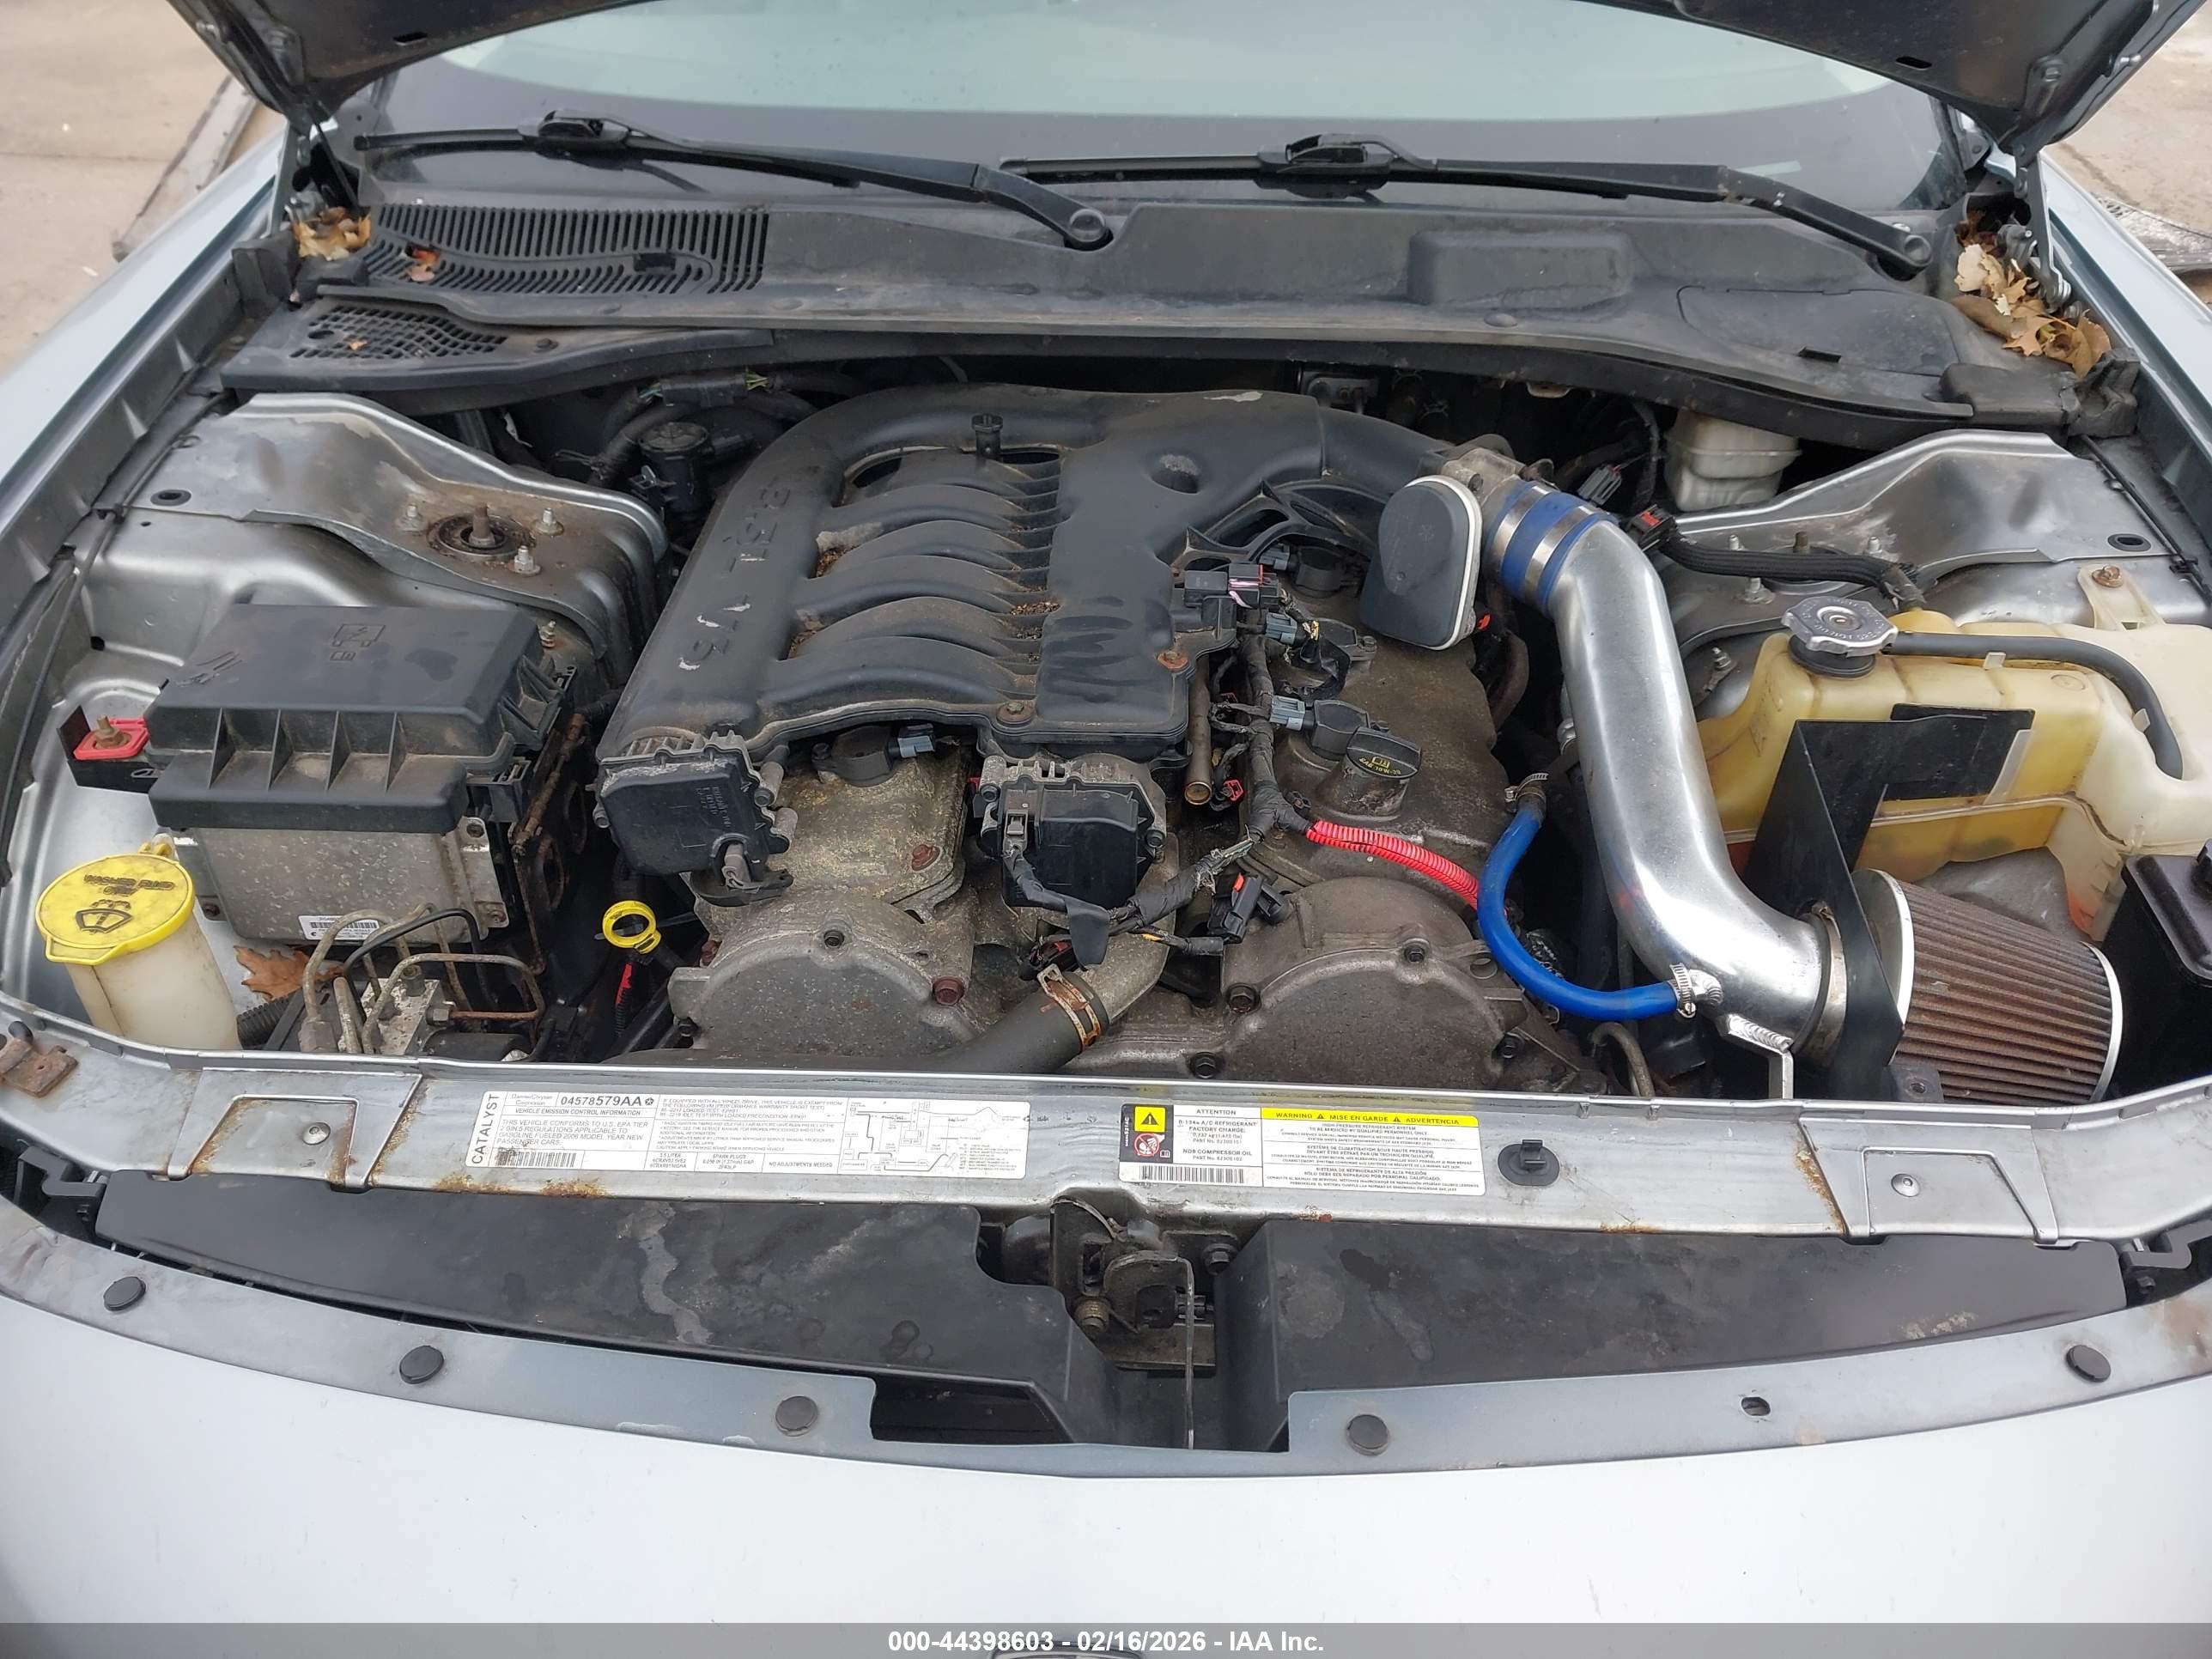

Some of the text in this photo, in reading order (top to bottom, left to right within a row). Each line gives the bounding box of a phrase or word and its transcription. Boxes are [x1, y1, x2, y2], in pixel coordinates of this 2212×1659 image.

[1358, 757, 1374, 768] SAE
[561, 1096, 641, 1106] 04578579AA
[471, 1094, 500, 1164] CATALYST
